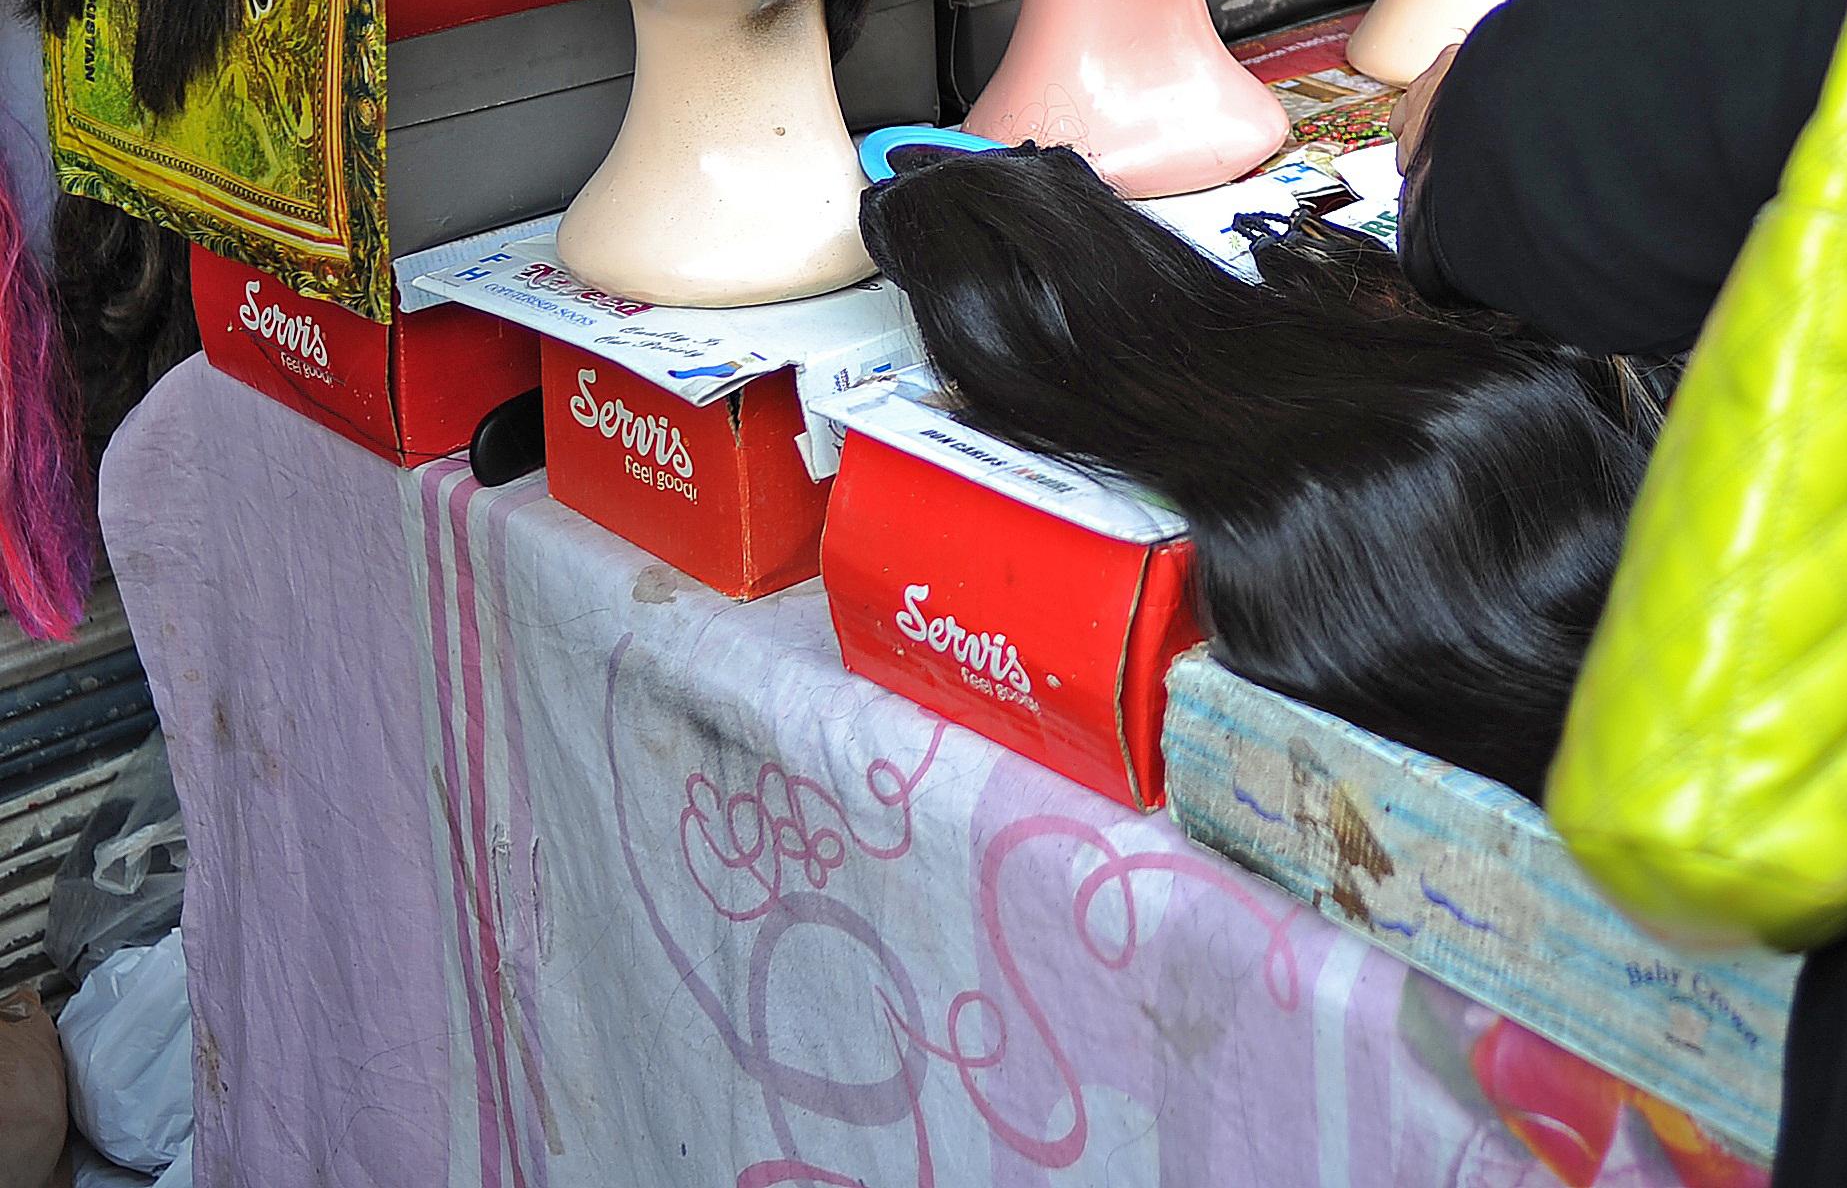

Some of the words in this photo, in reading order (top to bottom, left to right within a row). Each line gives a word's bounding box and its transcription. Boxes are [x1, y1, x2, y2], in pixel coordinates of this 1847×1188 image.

[239, 280, 328, 367] Servis
[569, 368, 694, 479] Servis
[625, 454, 654, 487] feel
[656, 470, 700, 506] good!
[895, 583, 1032, 695] Servis
